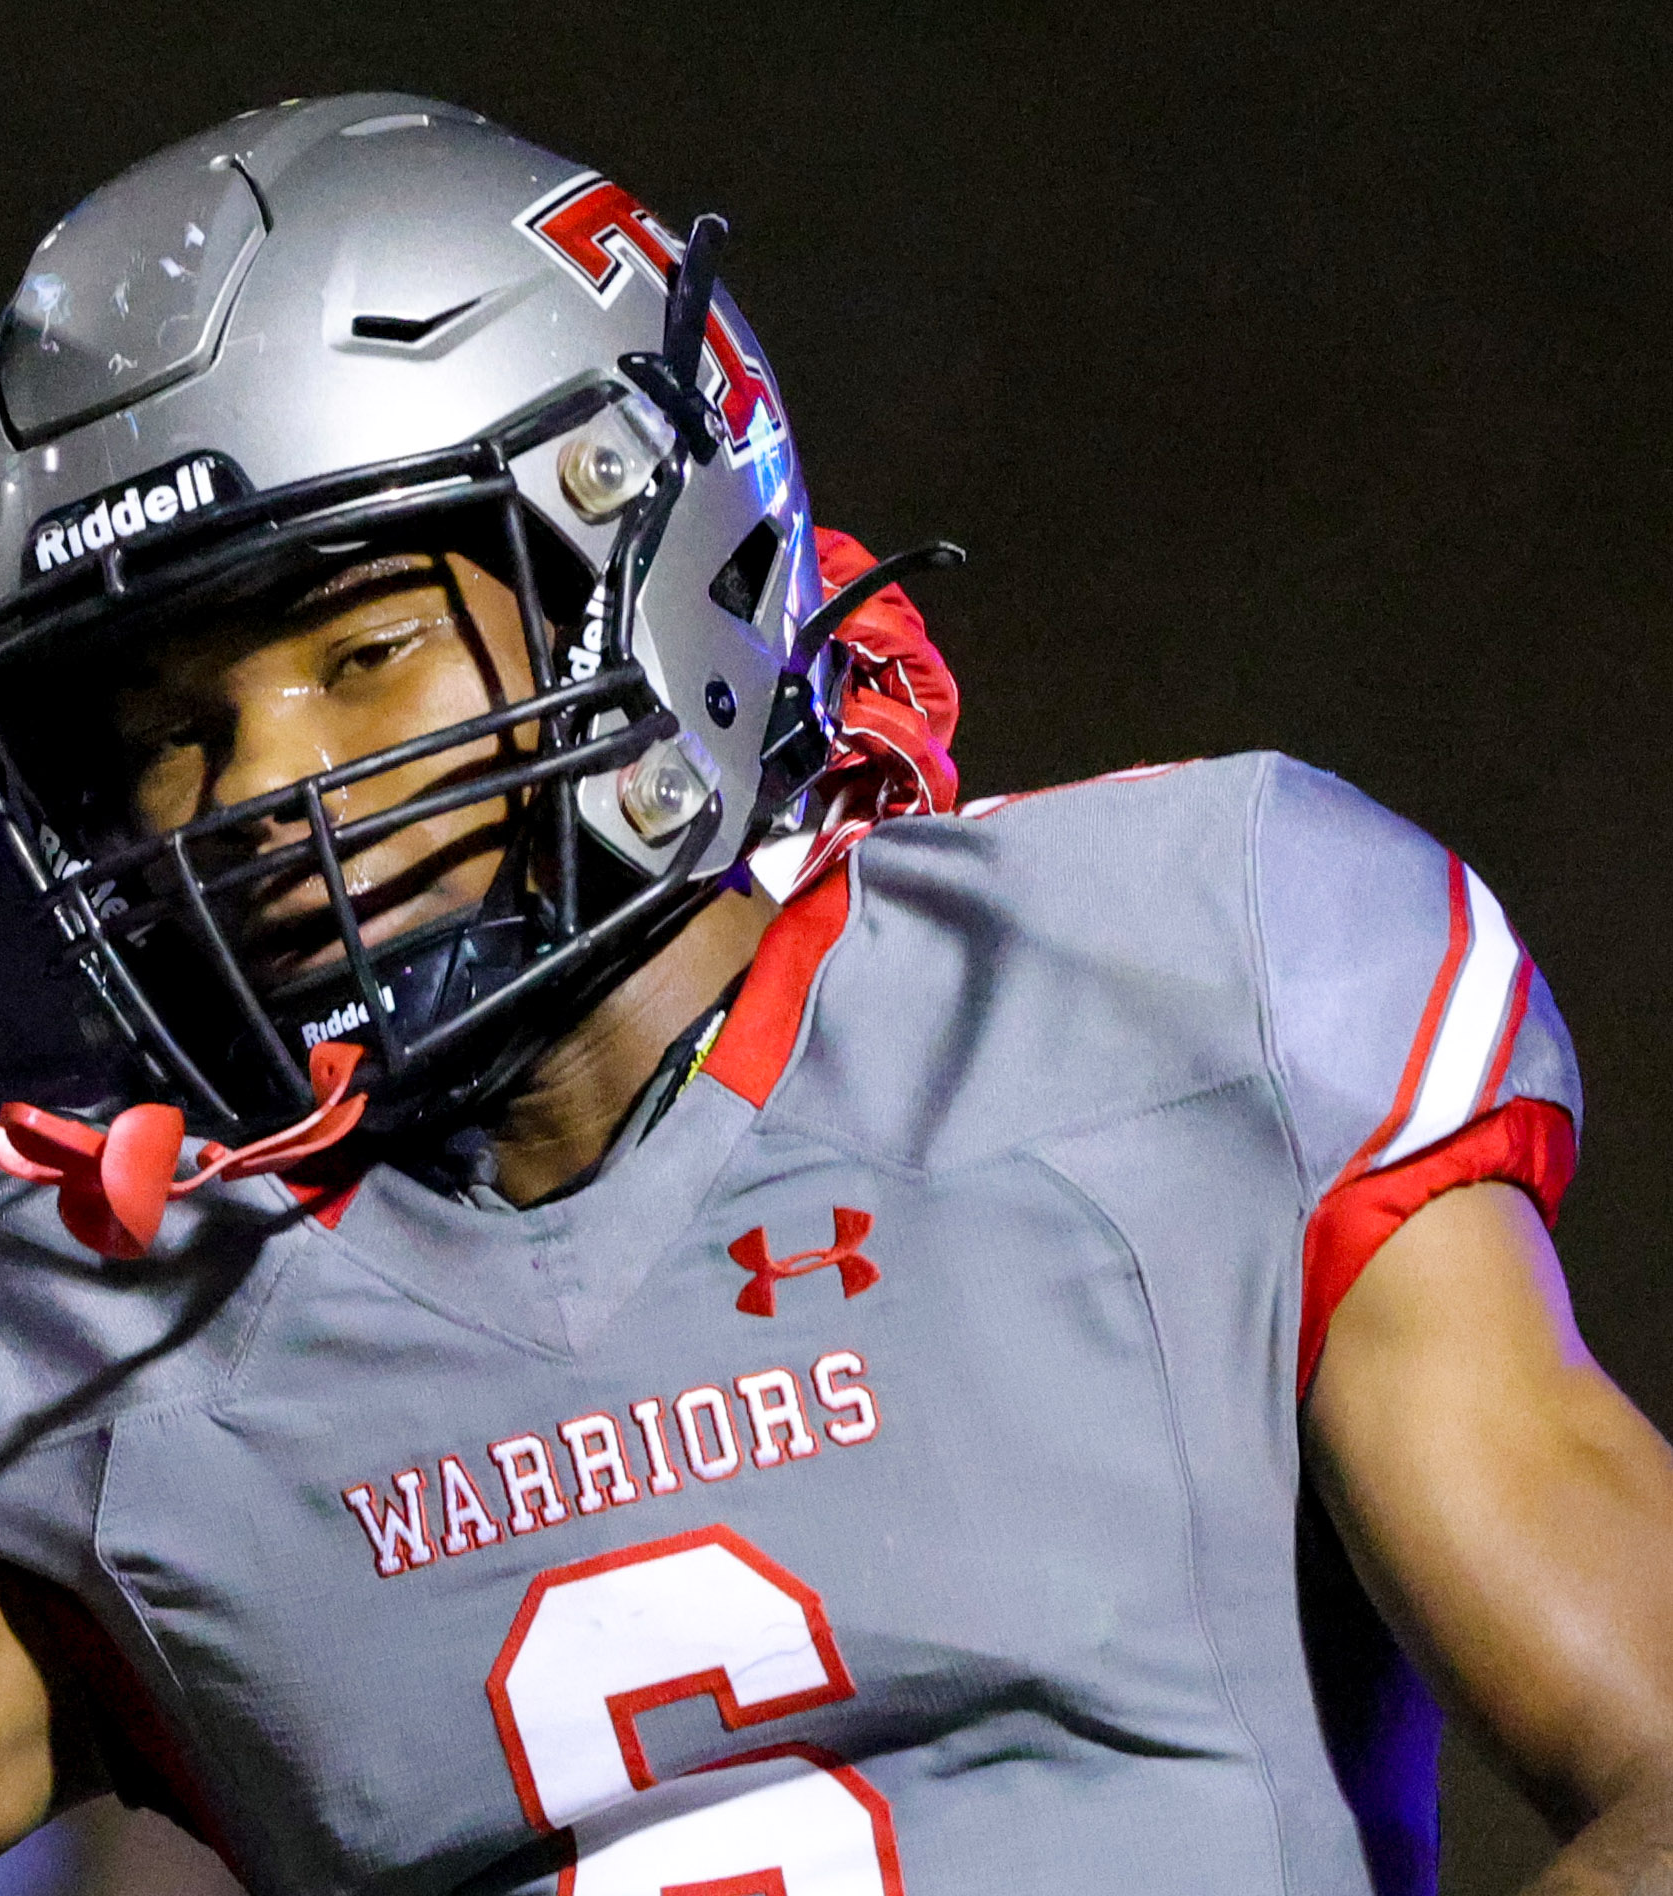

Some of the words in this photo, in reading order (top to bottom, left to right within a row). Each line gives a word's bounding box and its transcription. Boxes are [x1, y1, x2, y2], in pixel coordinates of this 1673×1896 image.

[35, 457, 216, 573] Riddell
[301, 985, 396, 1049] Riddl
[342, 1350, 881, 1578] WARRIORS
[485, 1522, 907, 1896] 6
